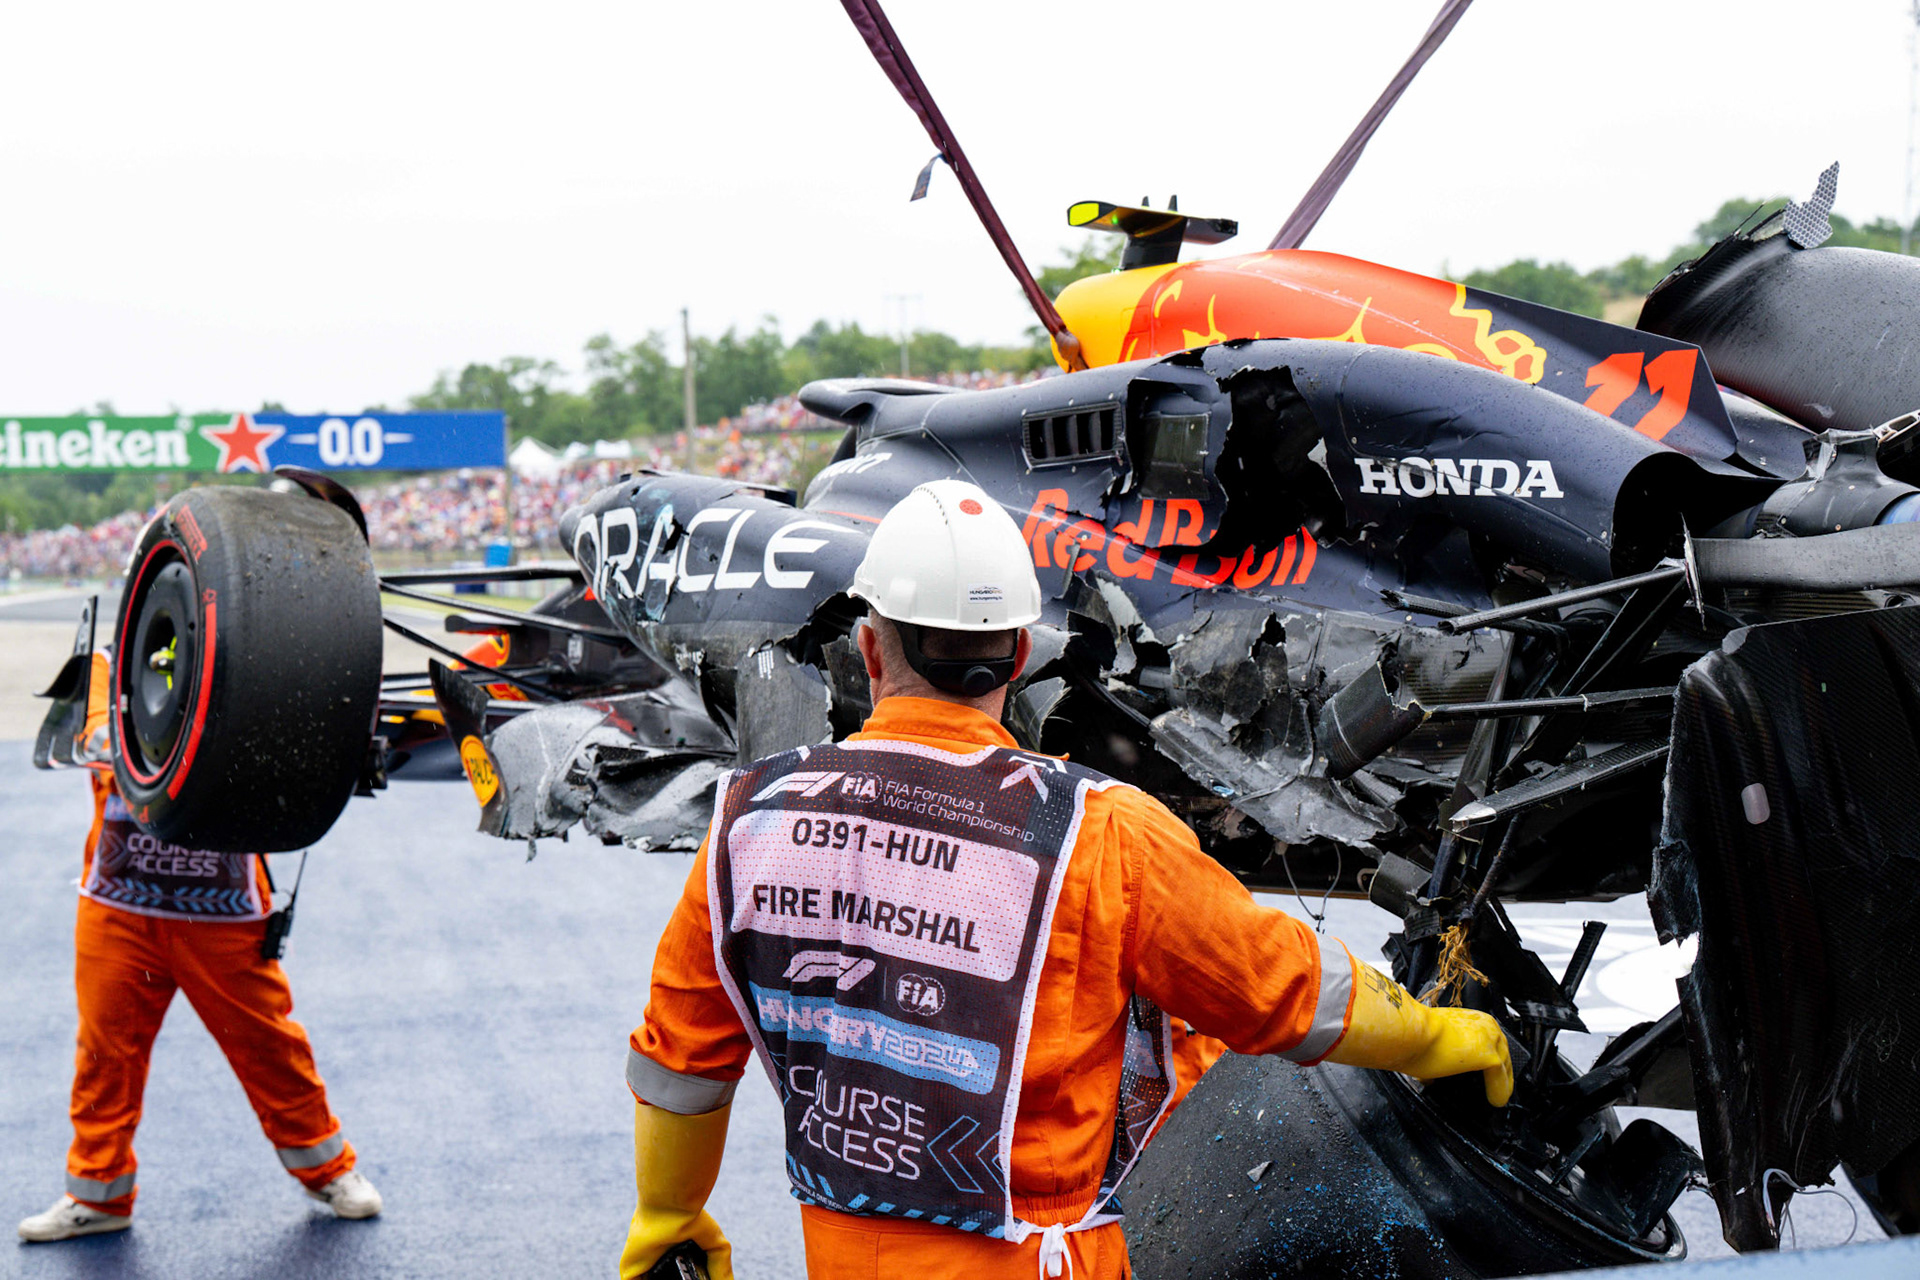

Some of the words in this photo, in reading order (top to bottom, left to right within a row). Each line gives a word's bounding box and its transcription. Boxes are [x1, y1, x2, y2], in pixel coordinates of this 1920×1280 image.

[1583, 349, 1698, 441] 11
[0, 420, 191, 467] ineken
[1354, 457, 1564, 498] HONDA
[574, 503, 864, 600] ORACLE
[1021, 488, 1161, 580] Red
[883, 794, 925, 814] World
[928, 803, 1035, 842] Championship
[885, 780, 909, 795] FIA
[912, 786, 974, 811] Formula
[976, 801, 985, 814] 1
[126, 853, 219, 878] ACCESS
[792, 817, 960, 873] 0391-HUN
[752, 884, 821, 919] FIRE
[832, 890, 981, 953] MARSHAL
